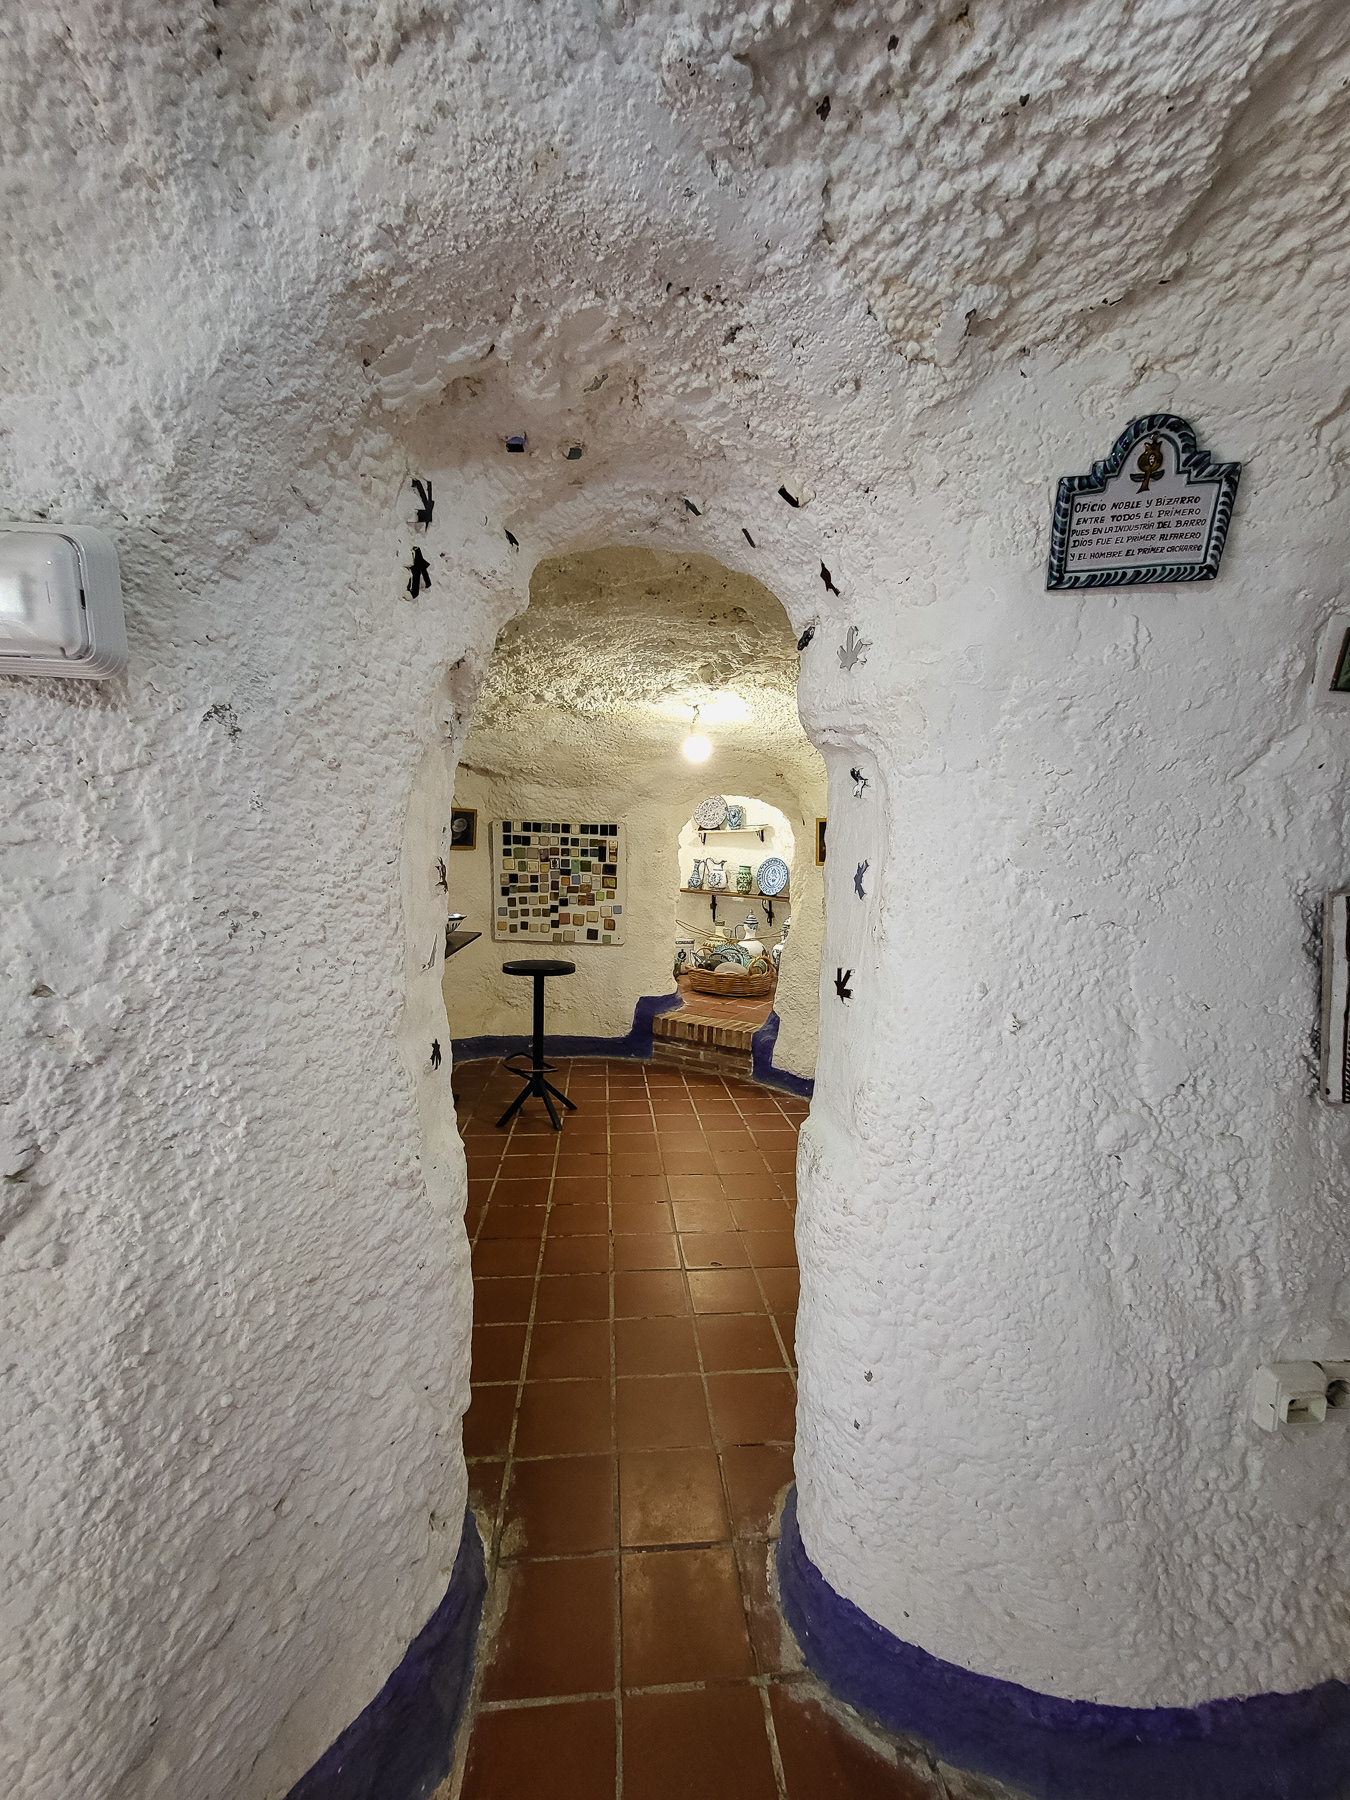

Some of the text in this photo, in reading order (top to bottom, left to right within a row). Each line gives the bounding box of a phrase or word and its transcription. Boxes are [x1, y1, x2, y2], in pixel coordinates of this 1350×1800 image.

[1111, 501, 1142, 510] NOBLE
[1076, 516, 1105, 525] ENTRE
[1111, 513, 1140, 522] TODOS
[1071, 529, 1089, 537] PUES
[1156, 521, 1171, 529] DEL
[1175, 519, 1206, 527] BARRO
[1159, 532, 1201, 541] ALFARERO
[1090, 551, 1123, 559] HOMBRE
[1166, 545, 1203, 553] CACHARRO
